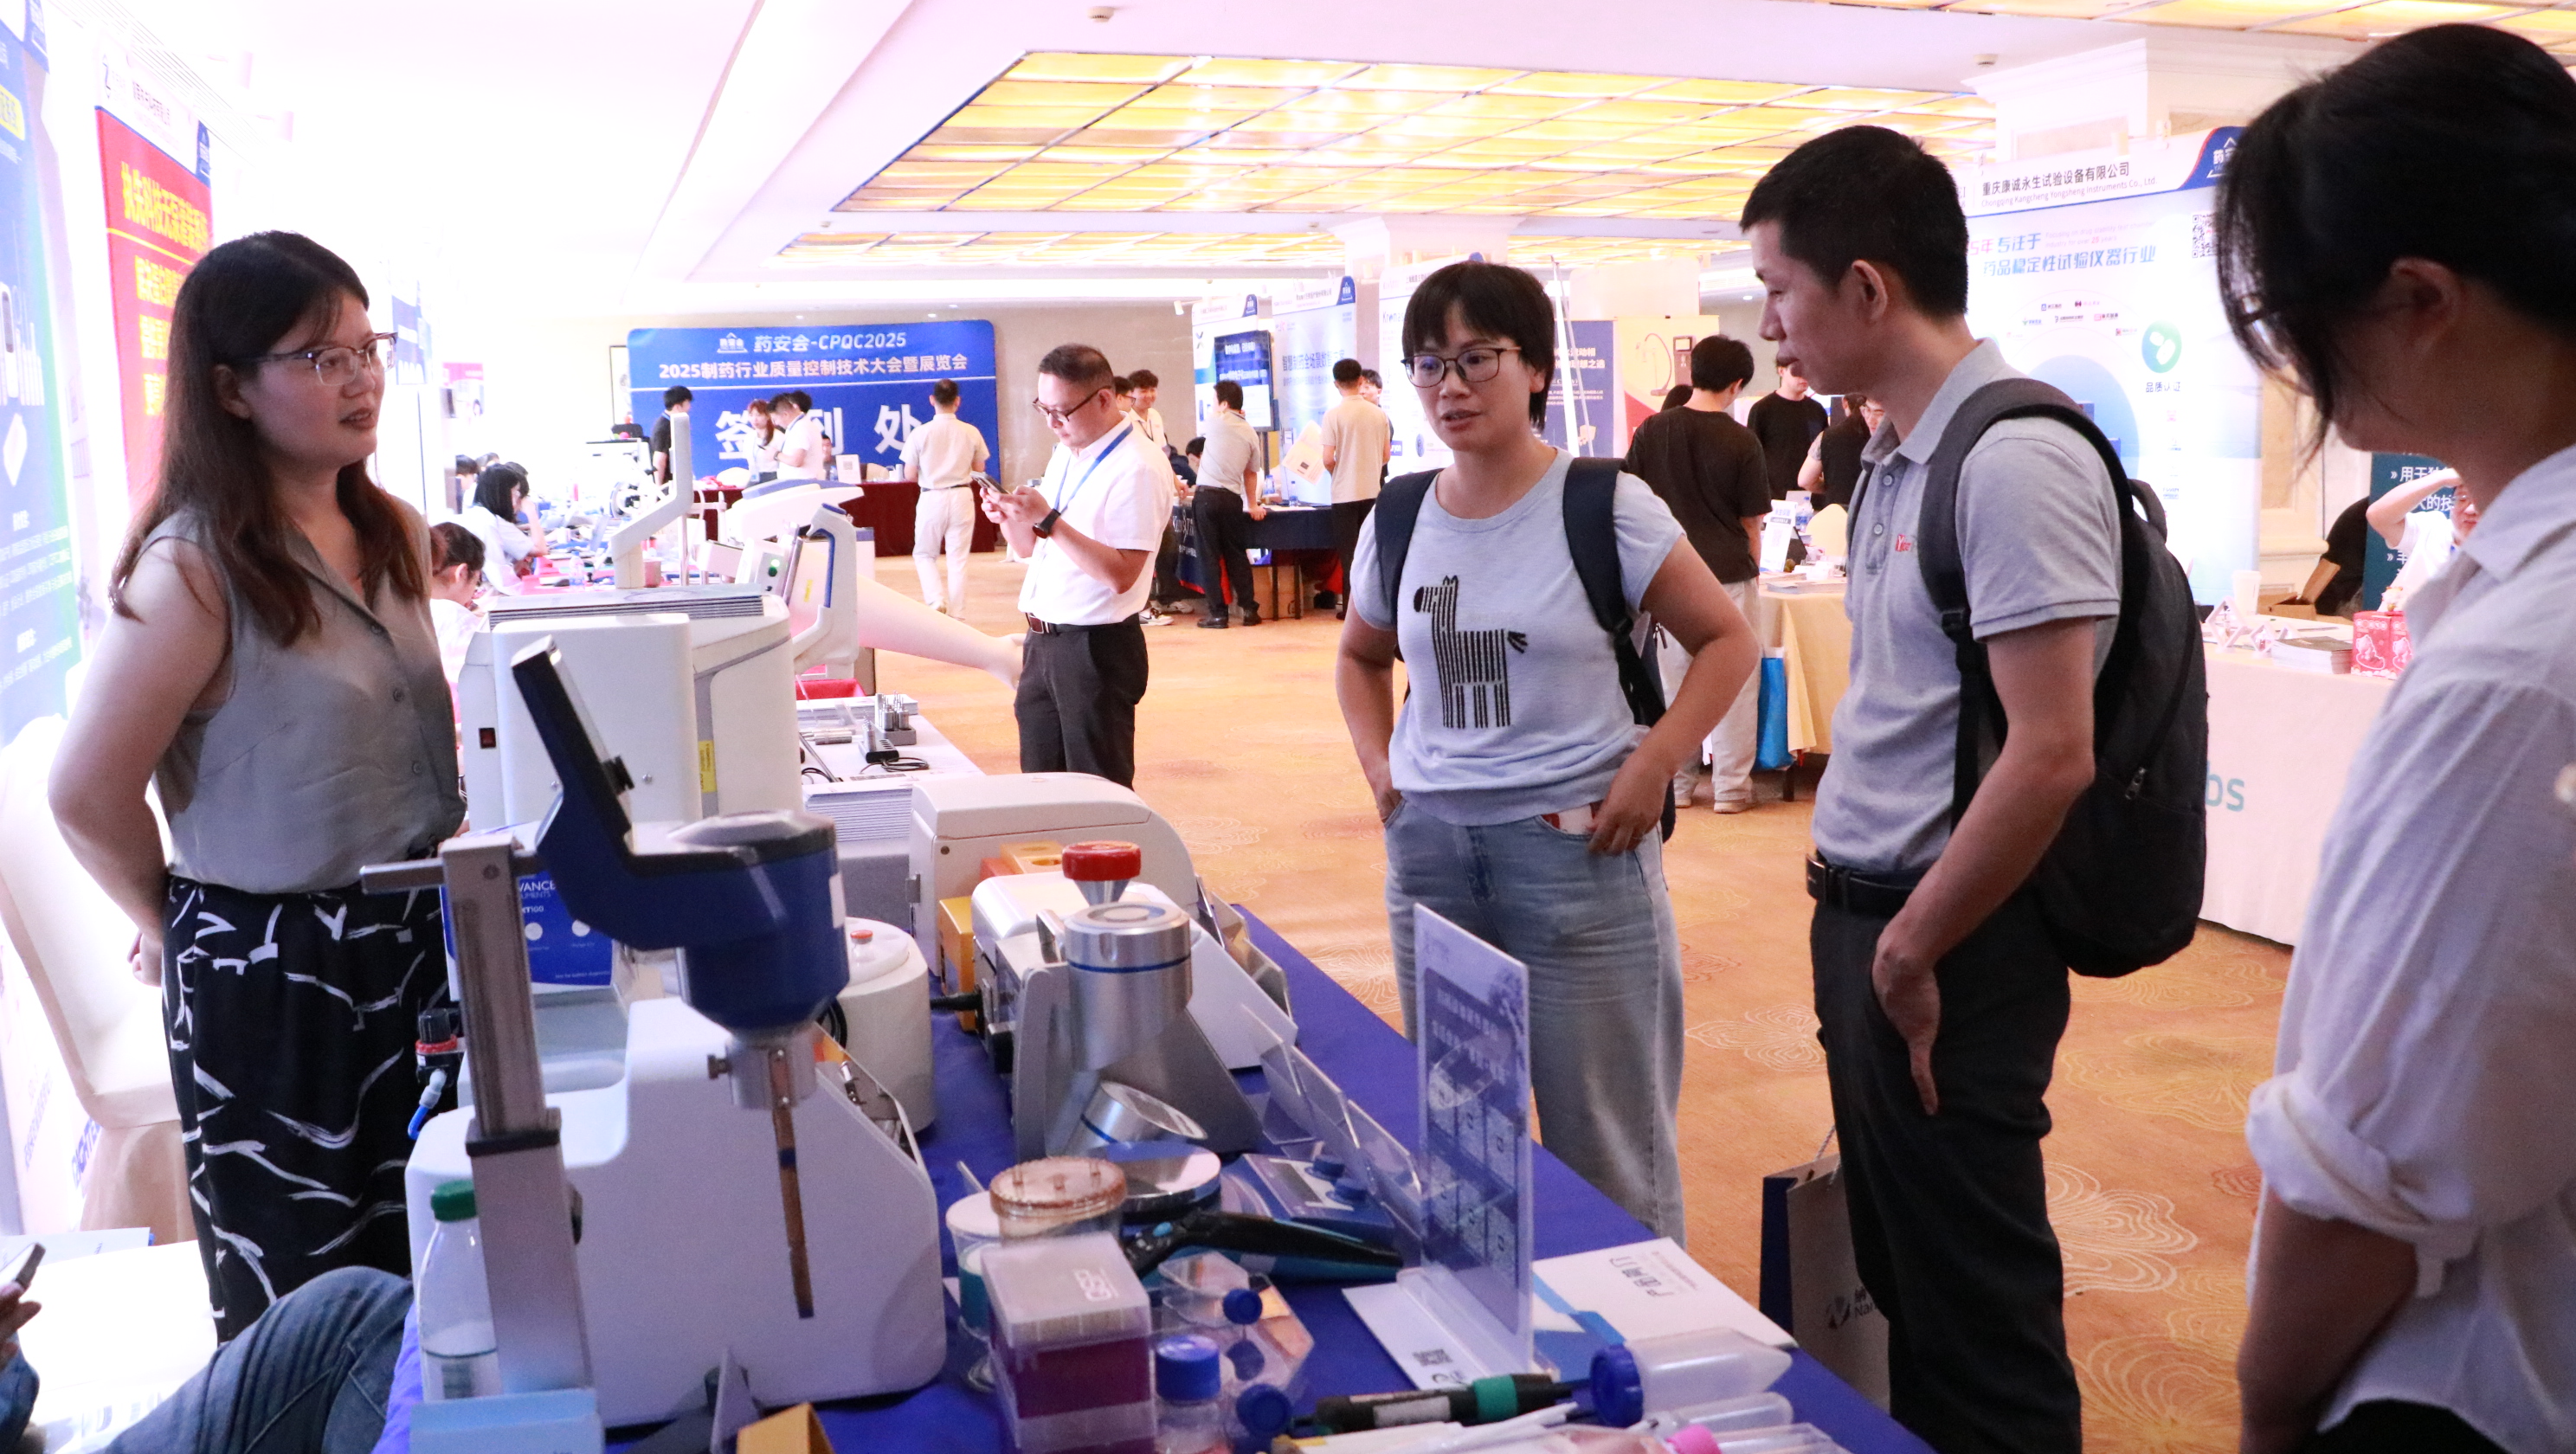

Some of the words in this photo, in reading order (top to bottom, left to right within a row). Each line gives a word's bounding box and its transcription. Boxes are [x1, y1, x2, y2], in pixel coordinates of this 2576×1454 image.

[1981, 196, 2013, 209] Chongqing
[2014, 192, 2050, 206] Kangcheng
[2050, 187, 2085, 201] Yongsheng
[2086, 181, 2128, 193] Instruments
[2128, 178, 2143, 188] Co.,
[2144, 176, 2158, 185] Ltd.
[1982, 162, 2129, 197] 重庆康诚永生试验设备有限公司
[1968, 238, 1993, 255] 5年
[1998, 232, 2041, 254] 专注于
[1983, 245, 2156, 277] 药品稳定性试验仪器行业
[659, 353, 968, 379] 2025制药行业质量控制技术大会暨展览会
[2145, 382, 2181, 393] 品质认证
[2205, 760, 2245, 813] bs
[519, 879, 556, 892] VANCE
